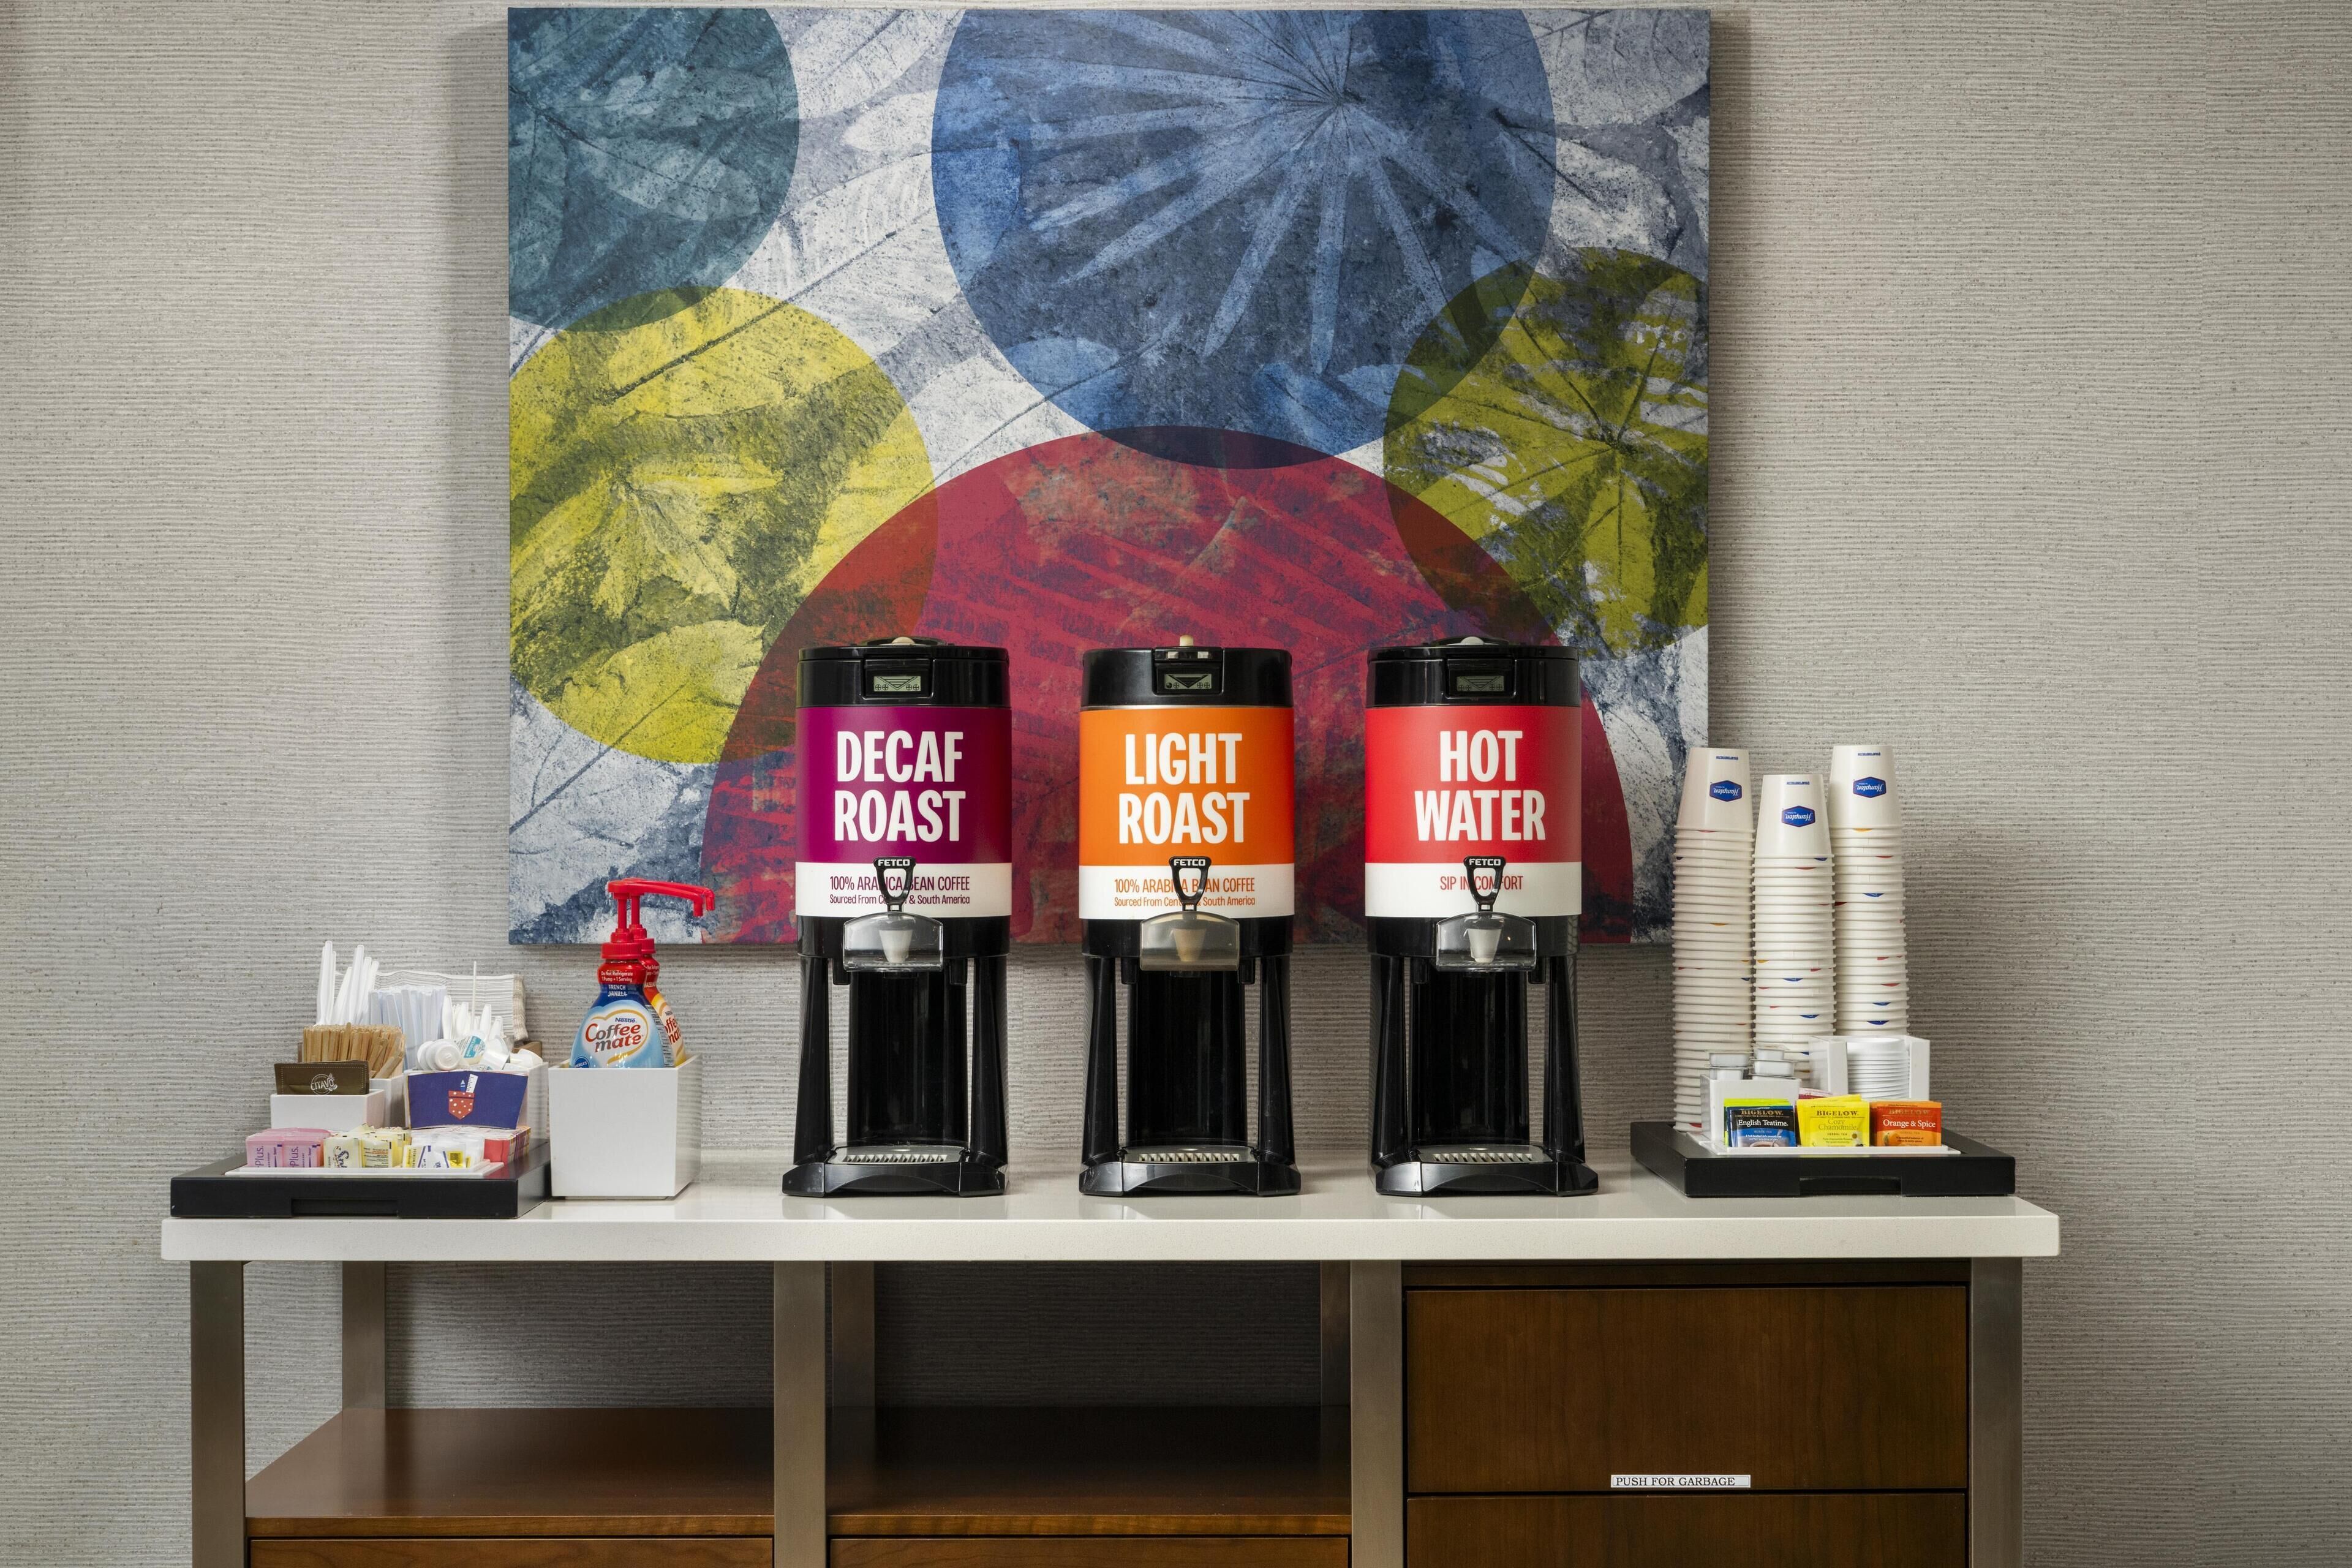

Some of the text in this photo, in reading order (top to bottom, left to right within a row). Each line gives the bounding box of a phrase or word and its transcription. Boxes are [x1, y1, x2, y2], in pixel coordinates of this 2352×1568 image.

[837, 730, 963, 783] DECAF
[1125, 733, 1243, 785] LIGHT
[1439, 729, 1523, 782] HOT
[1713, 788, 1740, 796] Hampton
[1856, 784, 1883, 793] Hampton
[834, 790, 966, 842] ROAST
[1119, 792, 1250, 845] ROAST
[1414, 790, 1546, 842] WATER
[1785, 813, 1812, 821] Hampton
[830, 876, 855, 891] 100%
[858, 876, 903, 891] ARAICA
[938, 876, 970, 891] COFFEE
[1114, 877, 1255, 893] 100% ARABIA BAN COFFEE
[1440, 876, 1457, 890] SIP
[1460, 876, 1471, 890] IN
[830, 894, 857, 904] Sourced
[858, 895, 876, 904] From
[909, 895, 916, 904] &
[918, 894, 940, 904] South
[941, 894, 970, 904] America
[1114, 897, 1142, 907] Sourced
[1143, 897, 1162, 907] From
[1164, 897, 1192, 907] Cent
[1203, 896, 1226, 906] South
[1227, 895, 1256, 906] America
[585, 1023, 641, 1042] Coffee
[595, 1034, 642, 1052] mate
[311, 1077, 334, 1091] CITAVO
[1883, 1118, 1909, 1128] Orange
[1918, 1120, 1936, 1129] Spice
[1616, 1477, 1735, 1486] PUSH FOR GARBAGE
